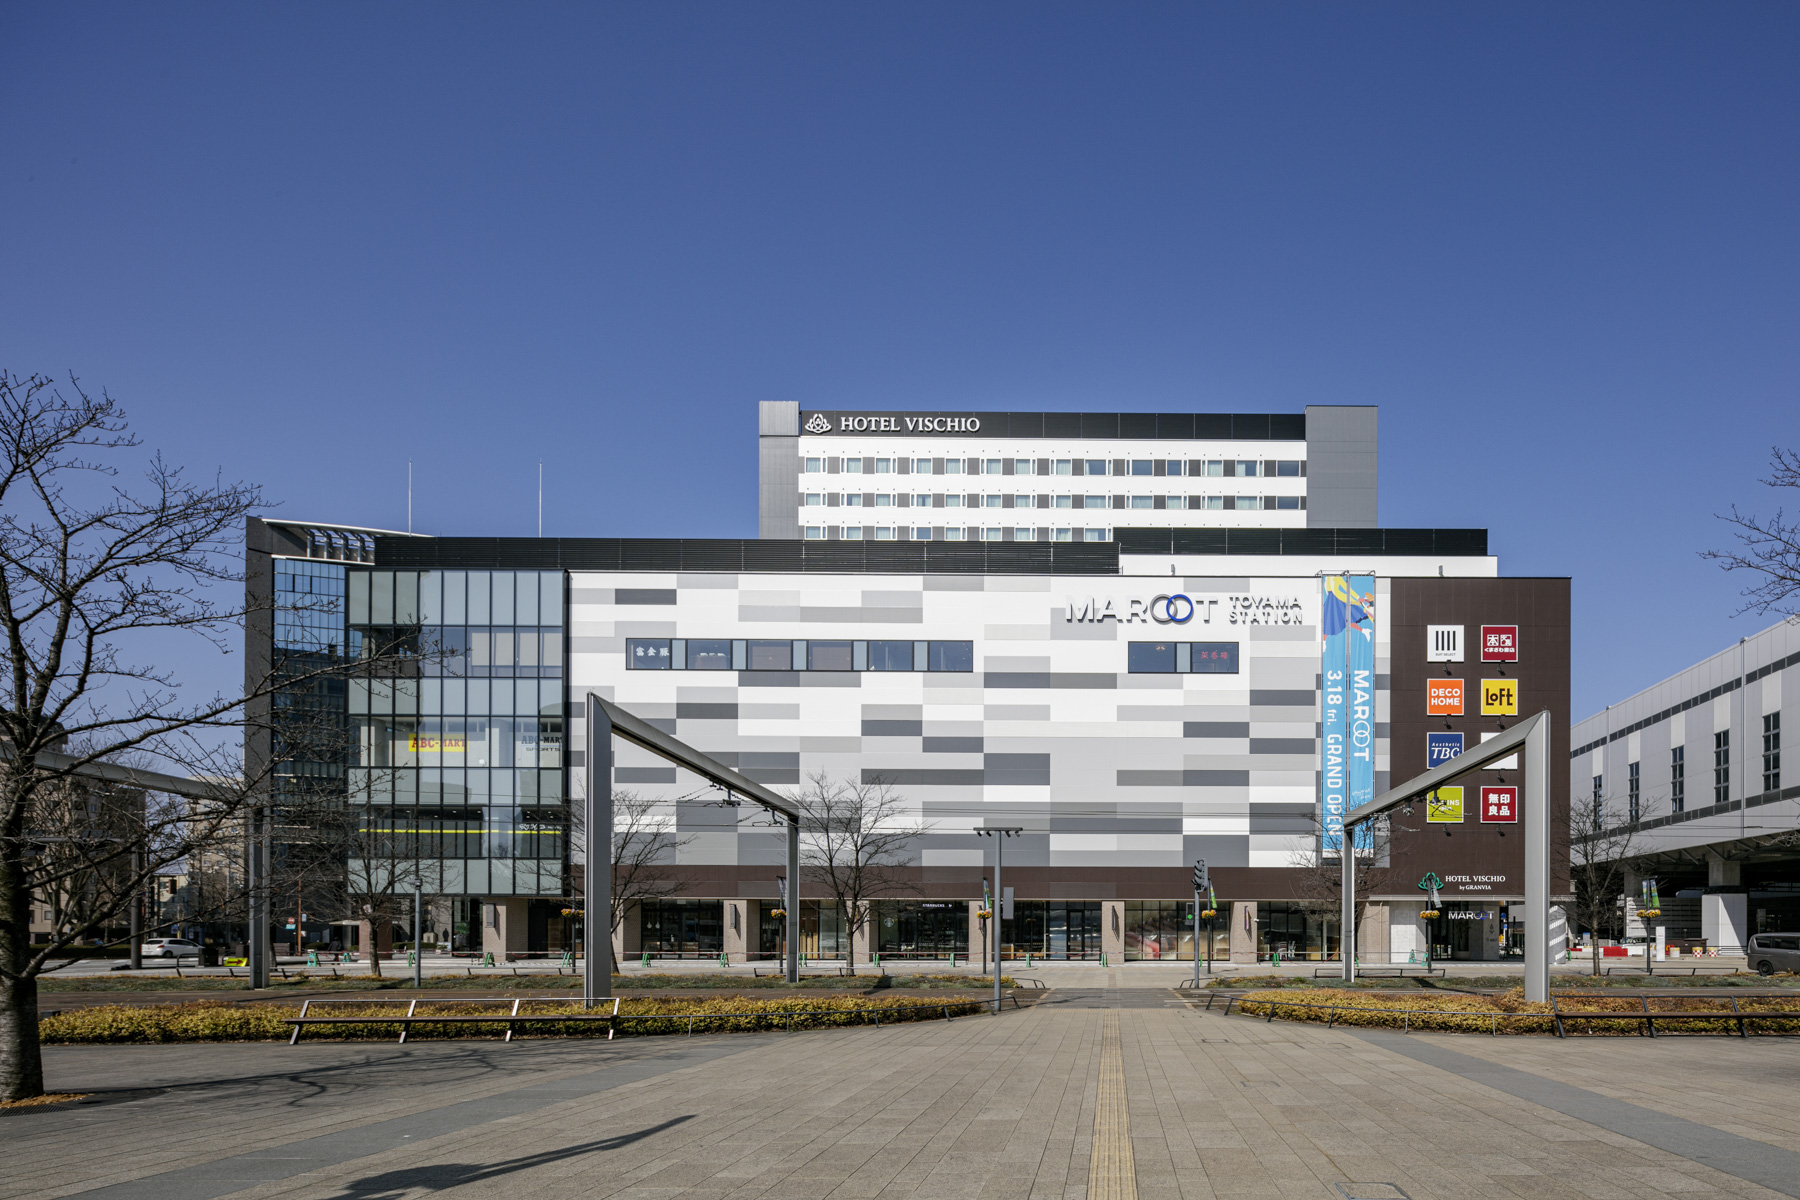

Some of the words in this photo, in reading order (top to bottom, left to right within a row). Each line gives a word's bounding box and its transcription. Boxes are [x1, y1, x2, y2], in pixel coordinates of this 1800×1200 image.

[841, 417, 900, 431] HOTEL
[905, 417, 980, 432] VISCHIO
[1066, 594, 1219, 624] MAROOT
[1229, 596, 1302, 609] TOYAMA
[1229, 611, 1303, 625] STATION
[1327, 670, 1342, 705] 3.18
[1431, 688, 1460, 696] DECO
[1431, 697, 1460, 706] HOME
[1327, 709, 1337, 726] fri.
[1353, 670, 1370, 762] MAROOT
[1431, 747, 1460, 759] TBC
[1327, 734, 1342, 788] GRAND
[1488, 793, 1510, 804] 無印
[1327, 795, 1342, 836] OPEN
[1488, 805, 1510, 816] 良品
[1473, 875, 1506, 883] VISCHIO
[1448, 910, 1494, 920] MAROOT
